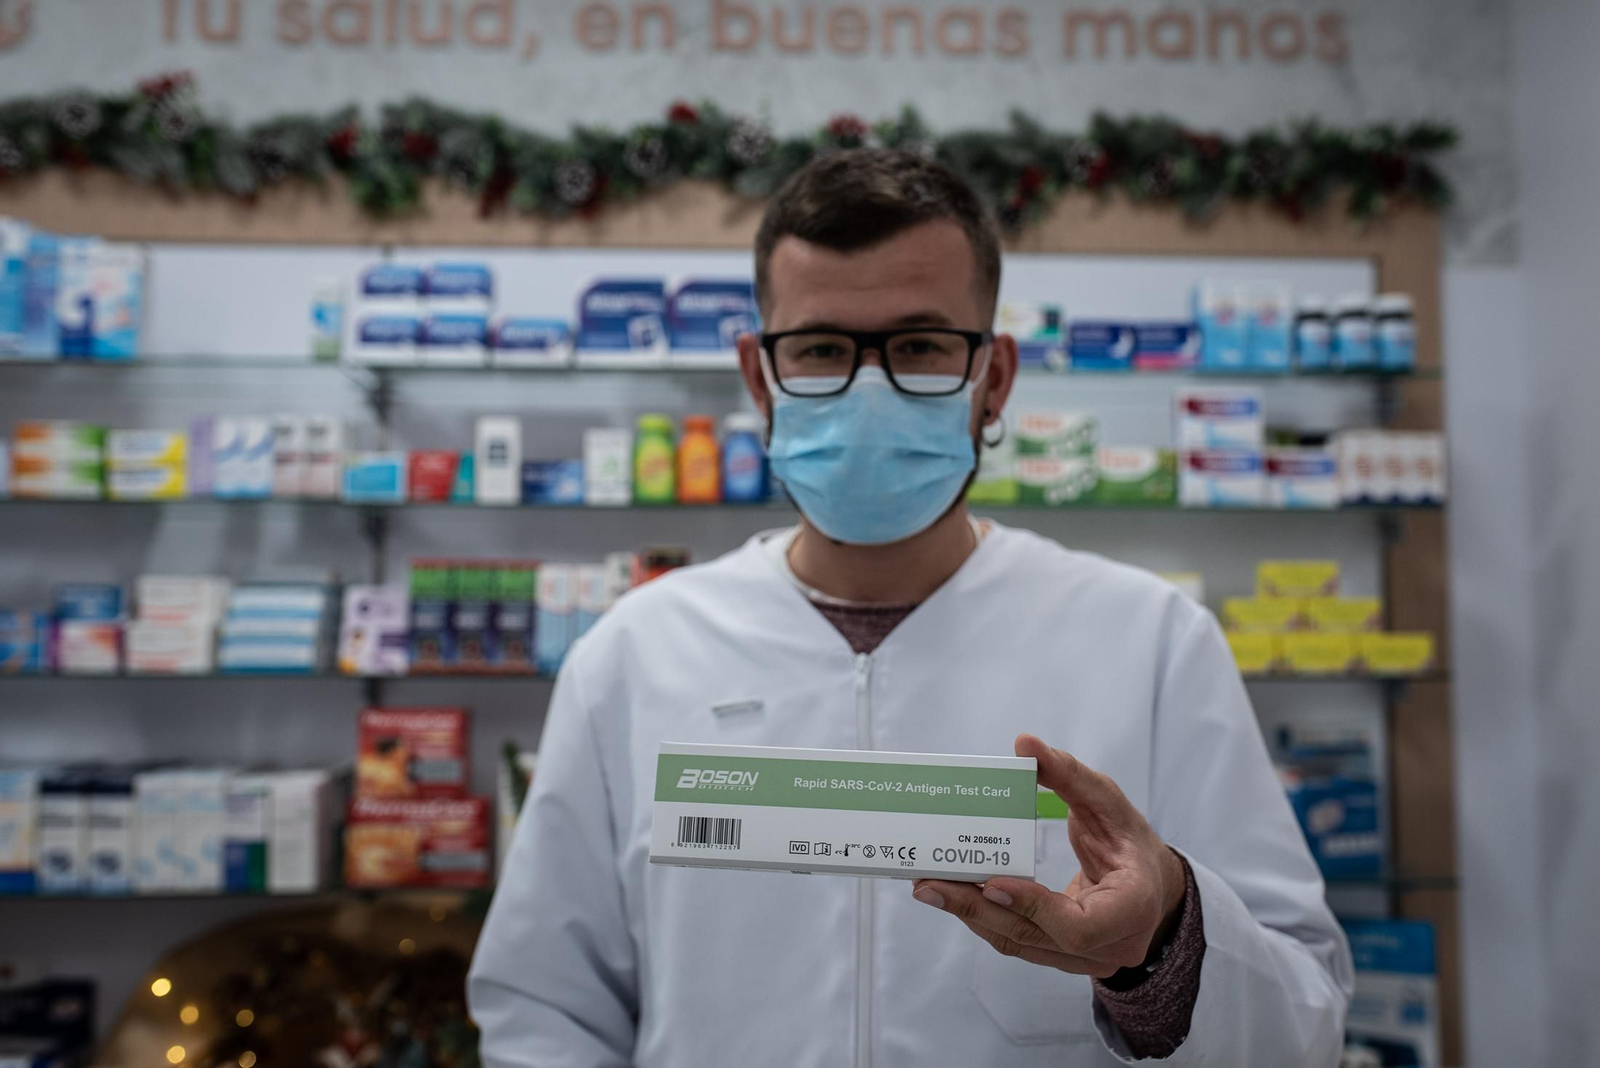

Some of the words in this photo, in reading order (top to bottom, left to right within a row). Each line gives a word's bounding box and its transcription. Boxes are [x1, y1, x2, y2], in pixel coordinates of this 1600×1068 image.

[275, 0, 539, 60] salud,
[571, 0, 680, 52] en
[709, 0, 1032, 58] buenas
[1060, 7, 1351, 64] manos
[676, 768, 759, 789] BOSON
[794, 777, 827, 790] Rapid
[830, 779, 903, 792] SARS-CoV-2
[905, 782, 951, 796] Antigen
[954, 784, 979, 796] Test
[982, 786, 1011, 797] Card
[792, 843, 807, 852] IVD
[958, 834, 971, 843] CN
[973, 835, 1011, 845] 205601.5
[898, 846, 916, 860] CE
[932, 847, 1010, 866] COVID-19
